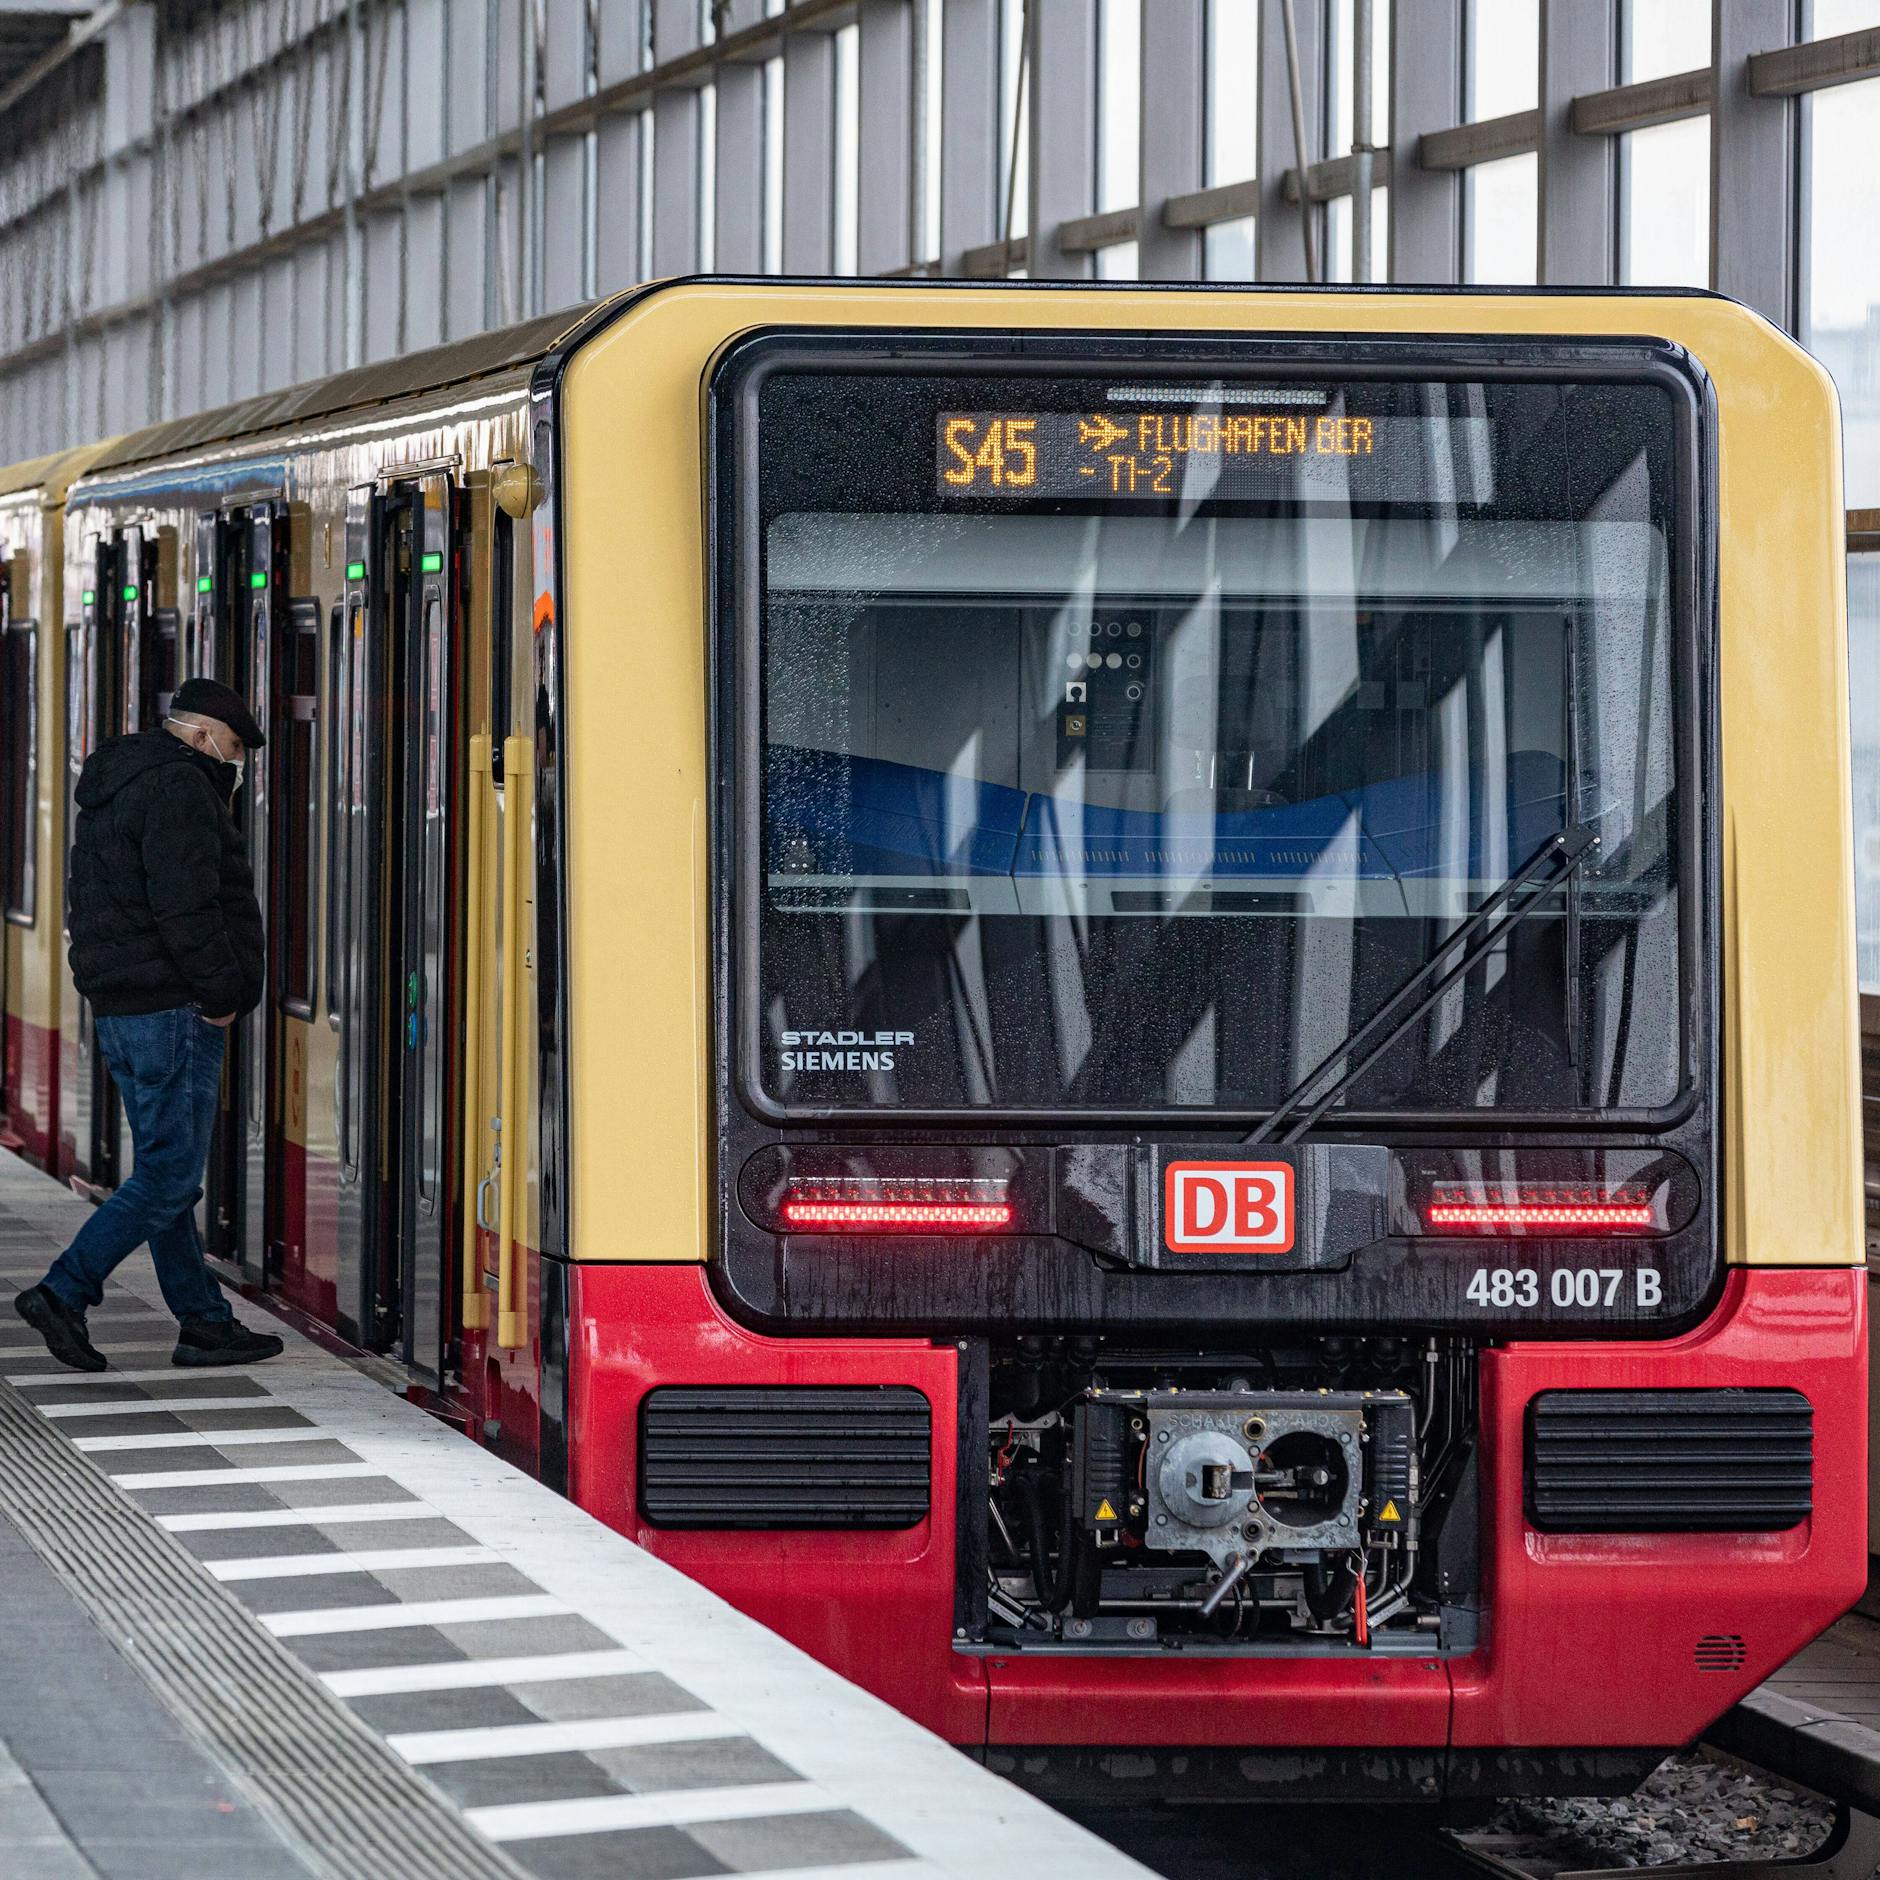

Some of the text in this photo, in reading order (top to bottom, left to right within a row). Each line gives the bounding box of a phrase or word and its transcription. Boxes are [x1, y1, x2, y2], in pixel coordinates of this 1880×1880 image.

[943, 419, 1036, 486] S45
[1139, 415, 1372, 454] FLUGHAFEN BER
[1107, 455, 1172, 491] T1-2
[781, 1031, 915, 1046] STADLER
[781, 1052, 895, 1071] SIEMENS
[1183, 1177, 1279, 1237] DB
[1466, 1268, 1663, 1307] 483 007 B
[1169, 1413, 1238, 1428] SCHAKU
